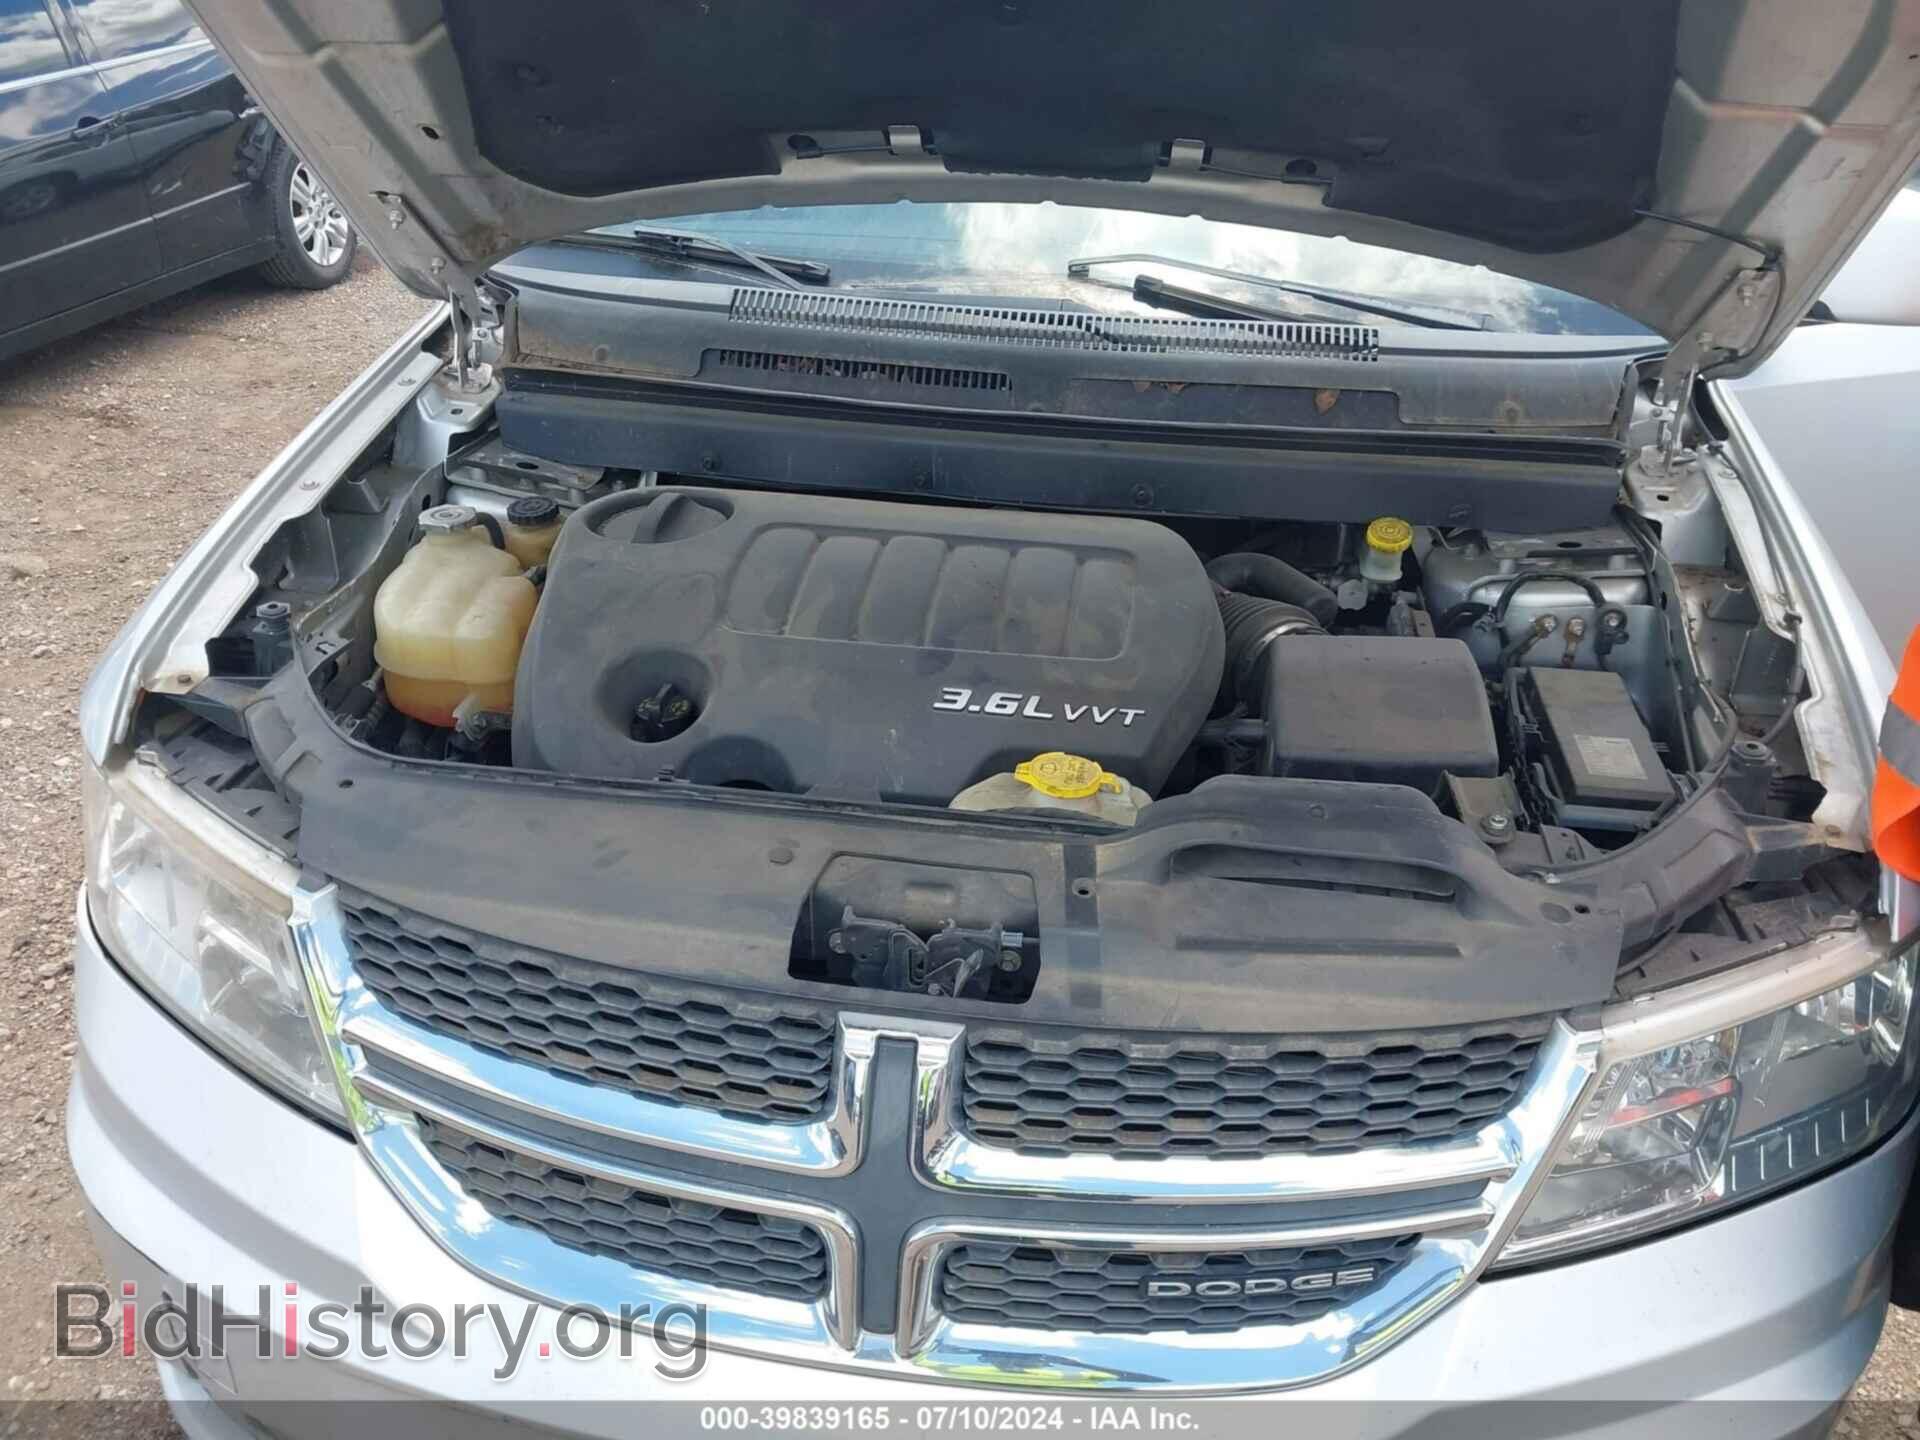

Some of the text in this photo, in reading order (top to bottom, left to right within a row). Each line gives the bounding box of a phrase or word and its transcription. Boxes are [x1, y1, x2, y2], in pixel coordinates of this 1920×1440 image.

[932, 687, 1145, 726] 3.6L VVT
[1148, 1267, 1374, 1297] DODGE
